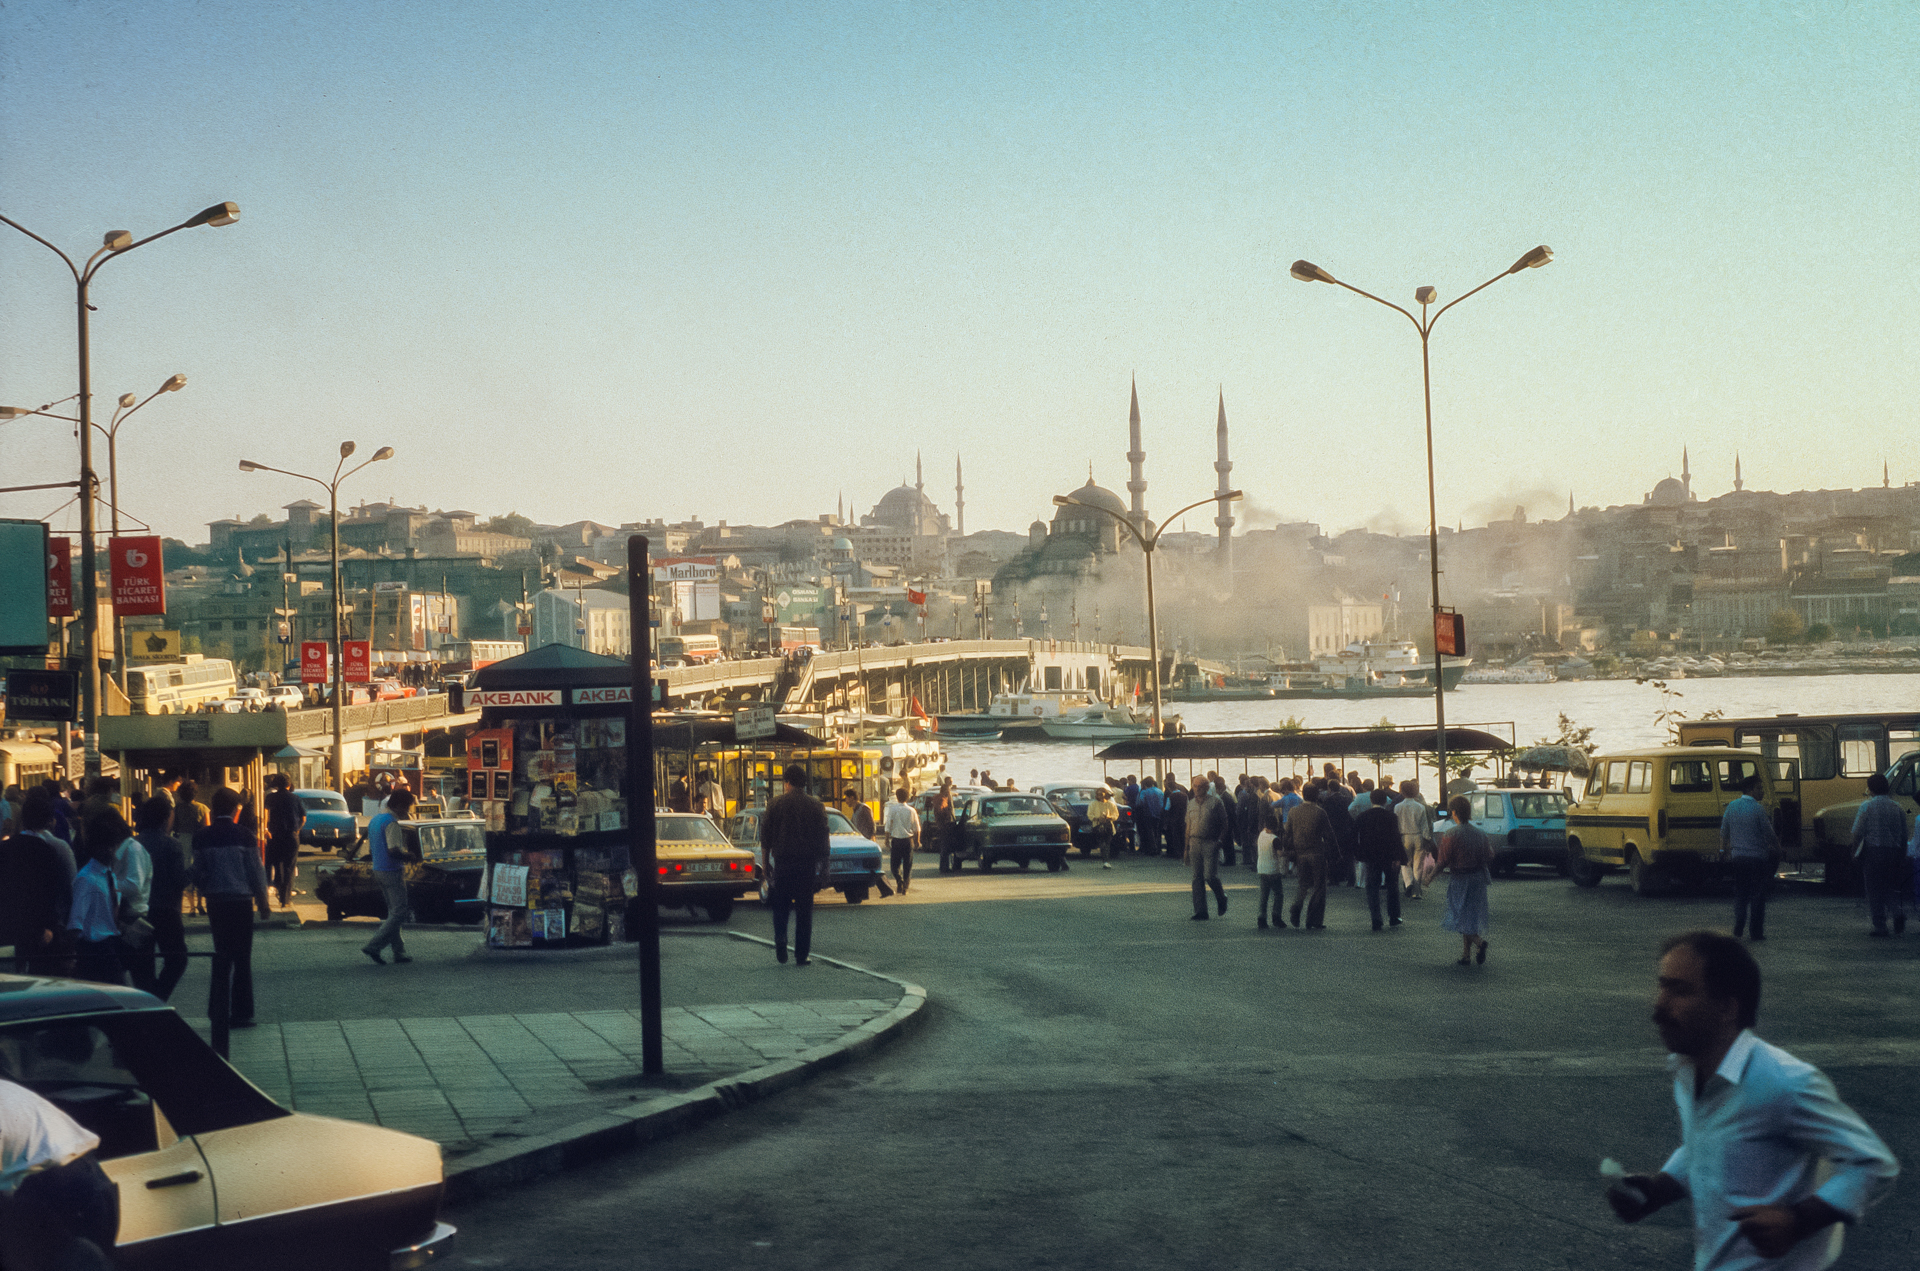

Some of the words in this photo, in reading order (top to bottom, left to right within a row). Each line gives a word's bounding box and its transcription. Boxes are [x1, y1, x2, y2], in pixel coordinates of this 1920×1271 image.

[670, 565, 716, 578] Marlboro
[123, 576, 150, 586] TÜRK
[117, 586, 157, 596] TİCARET
[116, 595, 159, 605] BANKASI
[10, 694, 70, 708] TÖBANK
[470, 691, 554, 706] AKBANK
